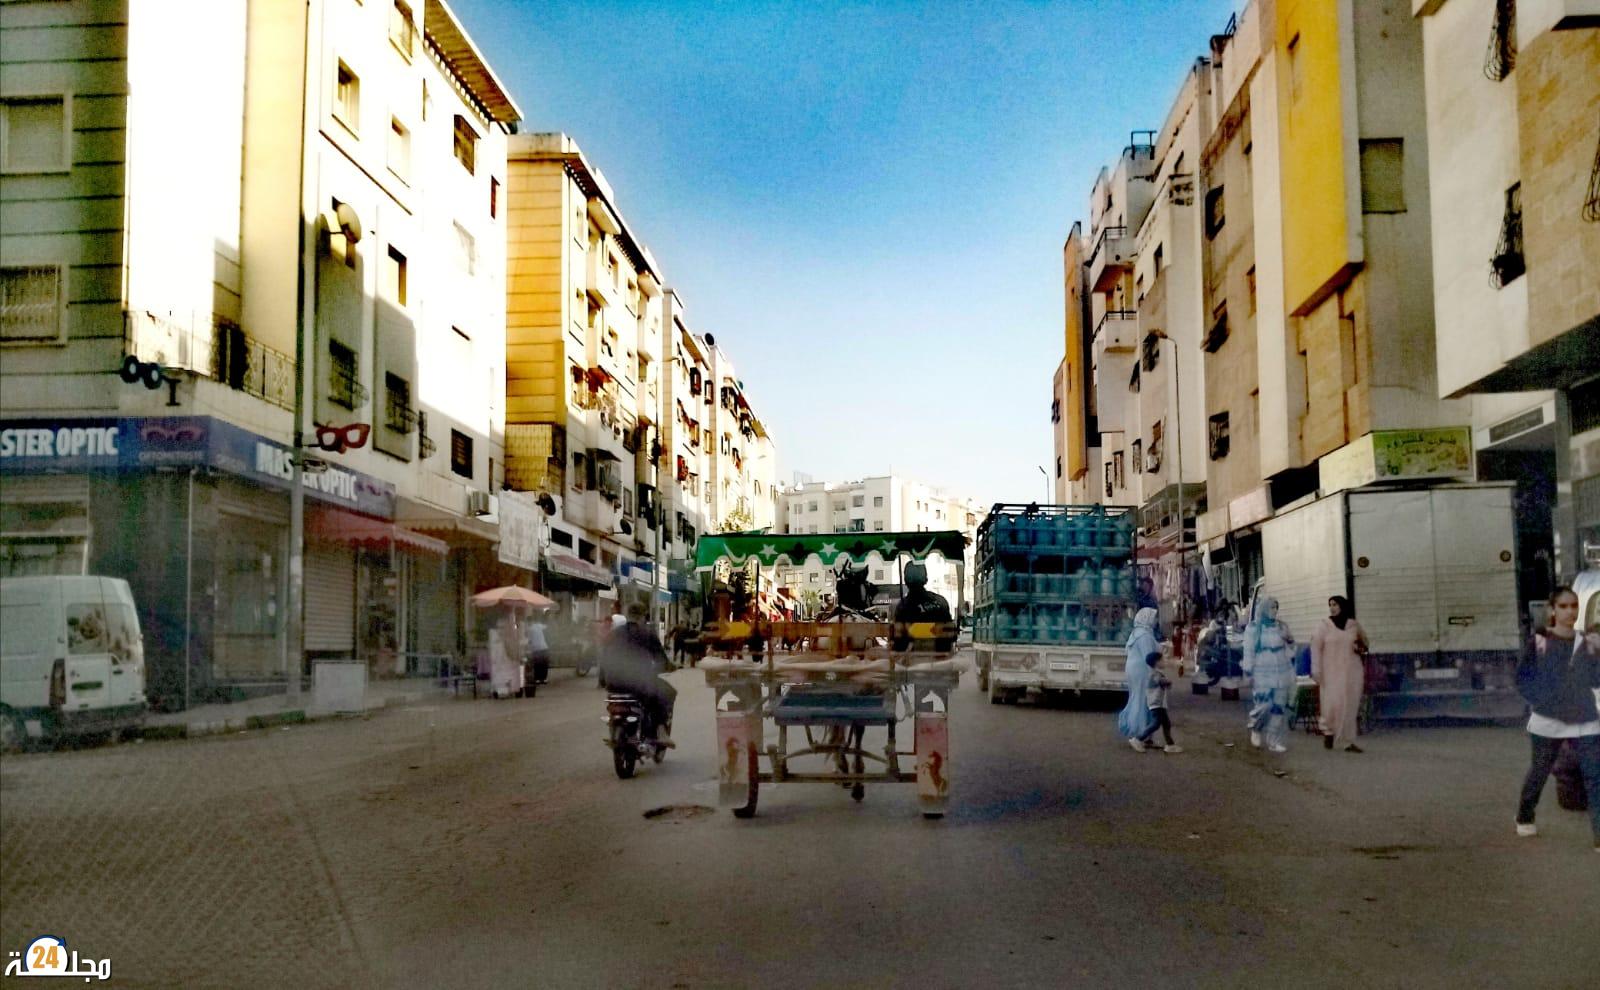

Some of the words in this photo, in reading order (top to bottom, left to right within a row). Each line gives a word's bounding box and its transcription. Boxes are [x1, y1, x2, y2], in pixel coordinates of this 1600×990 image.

[1, 428, 54, 456] STER
[56, 427, 120, 455] OPTIC
[256, 442, 319, 489] MASER
[319, 468, 359, 501] OPTIC
